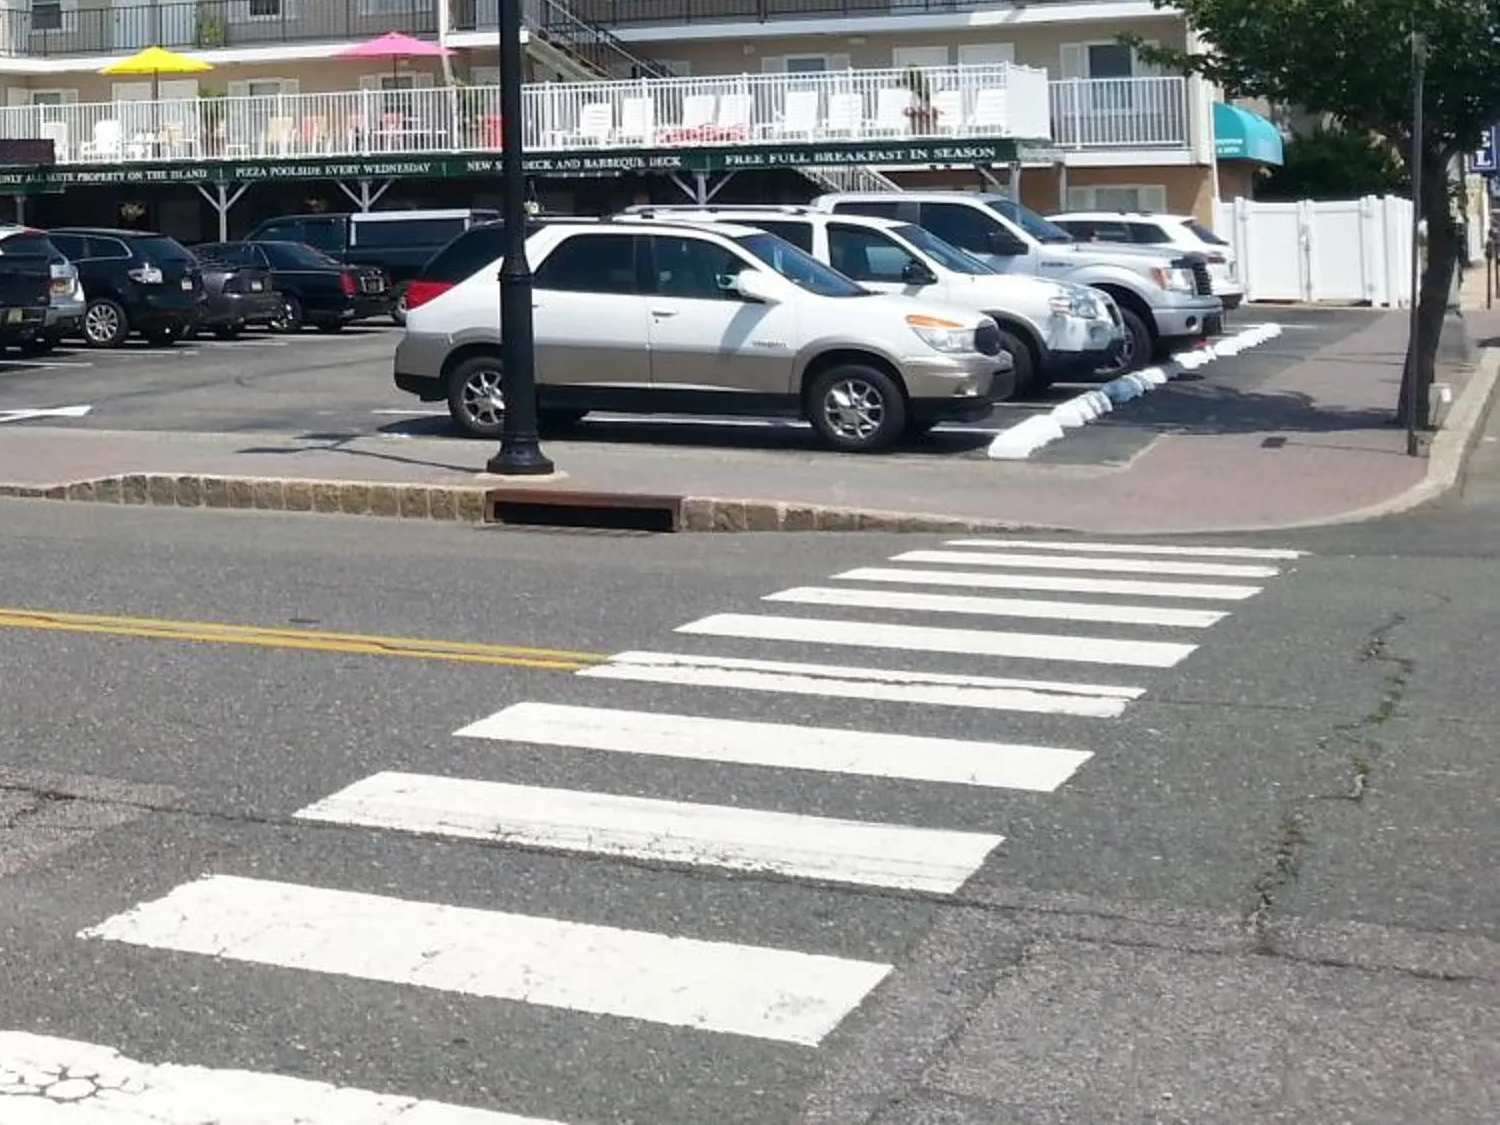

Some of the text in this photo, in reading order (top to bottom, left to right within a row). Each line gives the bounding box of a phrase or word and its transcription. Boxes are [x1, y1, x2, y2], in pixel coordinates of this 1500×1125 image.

[467, 160, 493, 171] NEW
[556, 158, 581, 169] AND
[649, 155, 682, 167] DECK
[725, 147, 996, 165] FREE FULL BREAKFAST IN SEASON
[127, 170, 143, 181] ON
[146, 170, 167, 180] THE
[235, 162, 432, 177] PIZZA POOLSIDE EVERY WEDNESDAY
